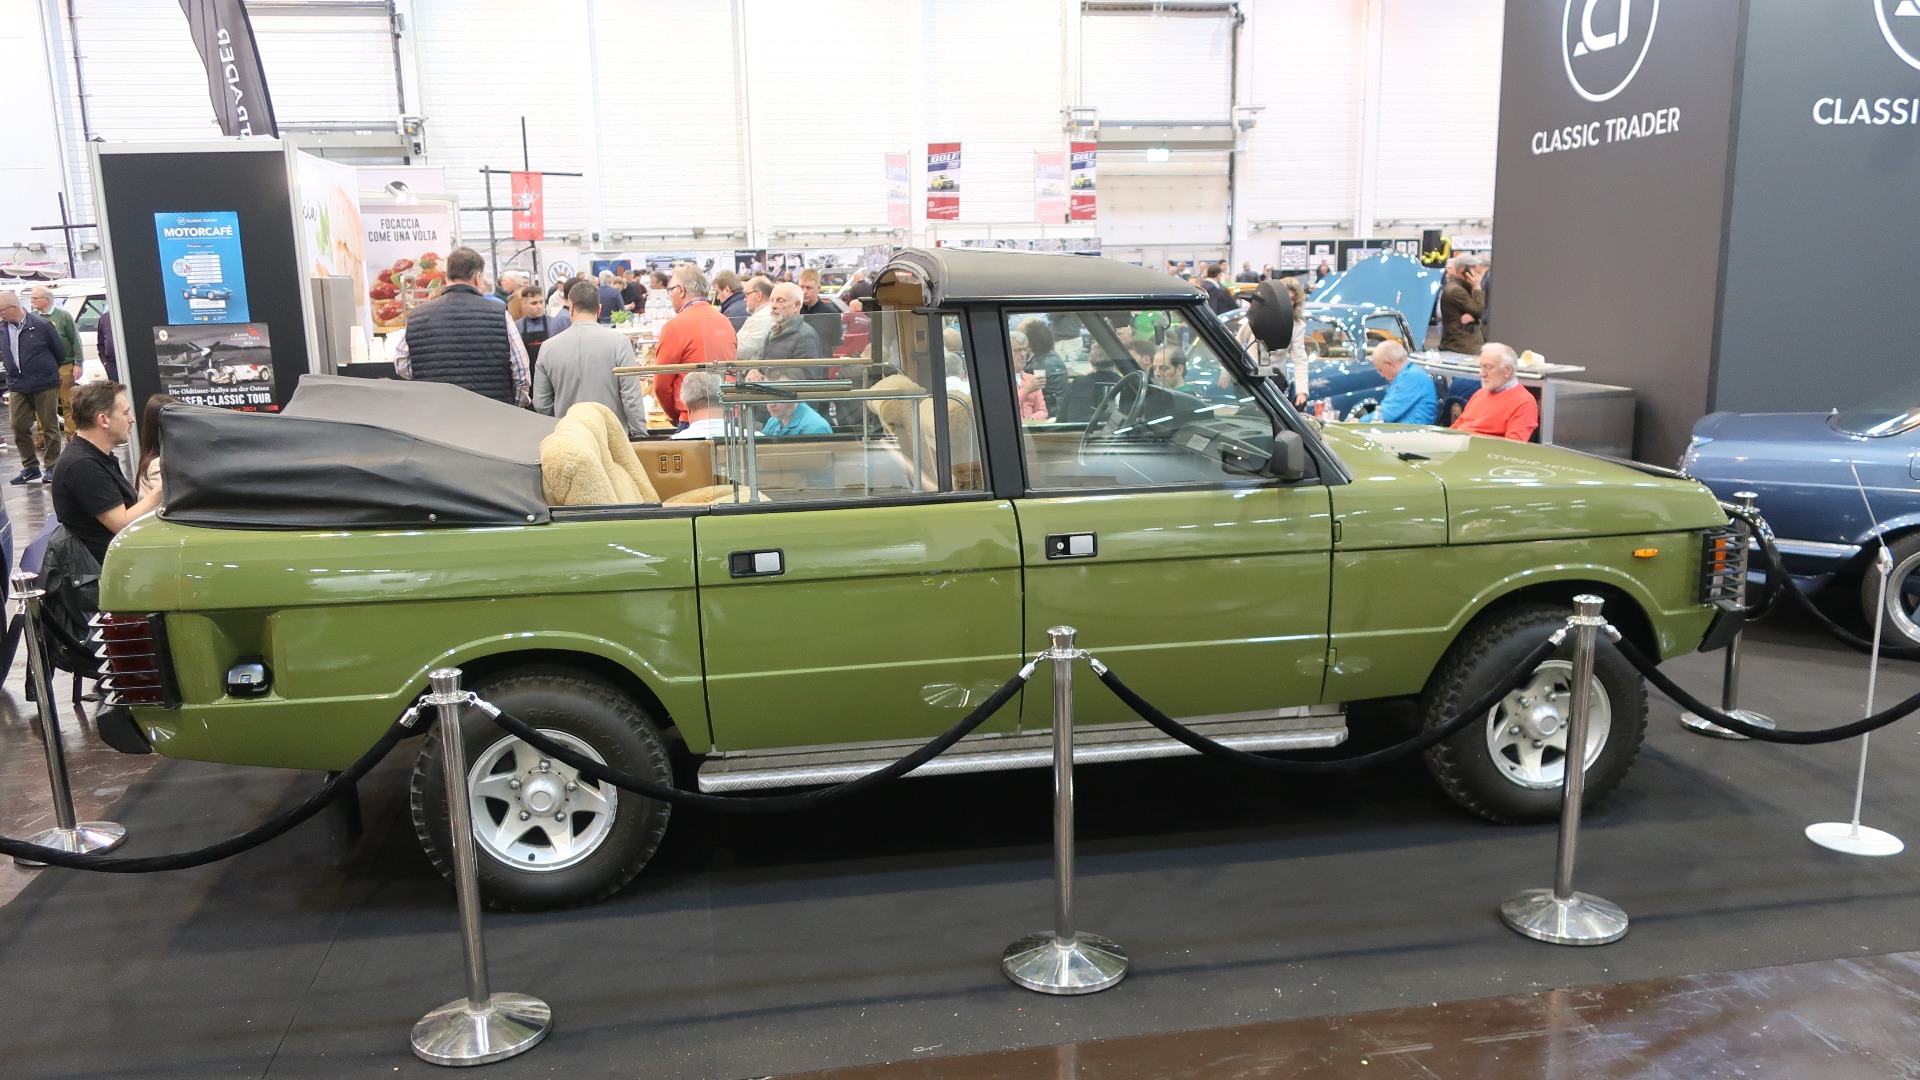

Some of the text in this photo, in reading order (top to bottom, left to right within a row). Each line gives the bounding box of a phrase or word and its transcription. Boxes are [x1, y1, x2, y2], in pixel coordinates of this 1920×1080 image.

[1812, 97, 1919, 126] CLASSI
[1531, 106, 1681, 155] CLASSIC TRADER
[380, 218, 420, 230] FOCACCIA
[164, 225, 234, 237] MOTORCAFÉ
[368, 230, 438, 242] COME UNA VOLTA
[181, 386, 229, 395] Oldtimer-Rallye
[247, 392, 272, 404] TOUR
